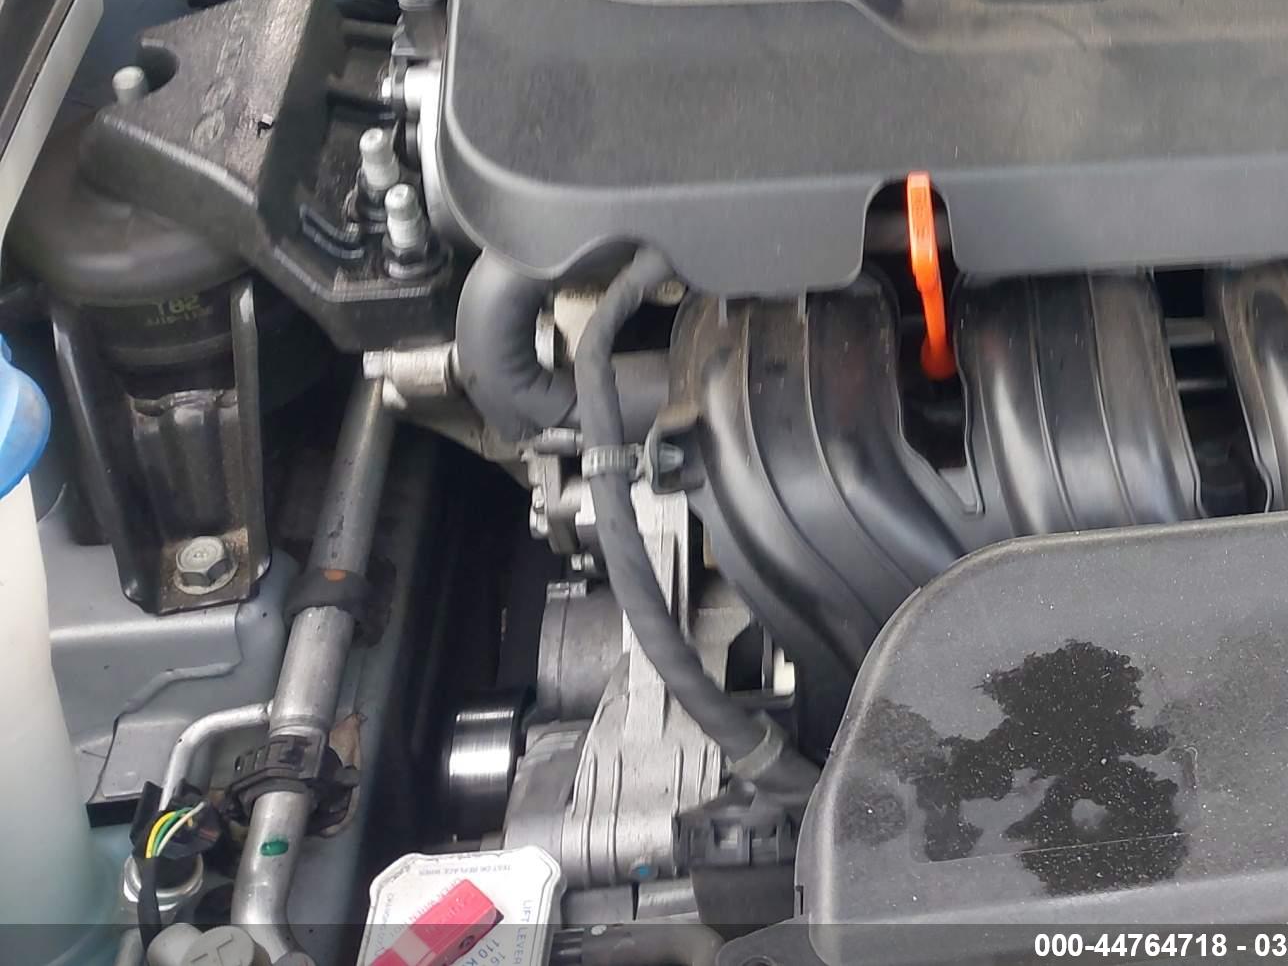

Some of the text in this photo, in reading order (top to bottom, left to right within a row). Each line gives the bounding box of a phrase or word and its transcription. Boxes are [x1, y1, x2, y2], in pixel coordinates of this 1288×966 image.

[478, 938, 500, 959] 110
[513, 900, 533, 965] LIFT LEVER
